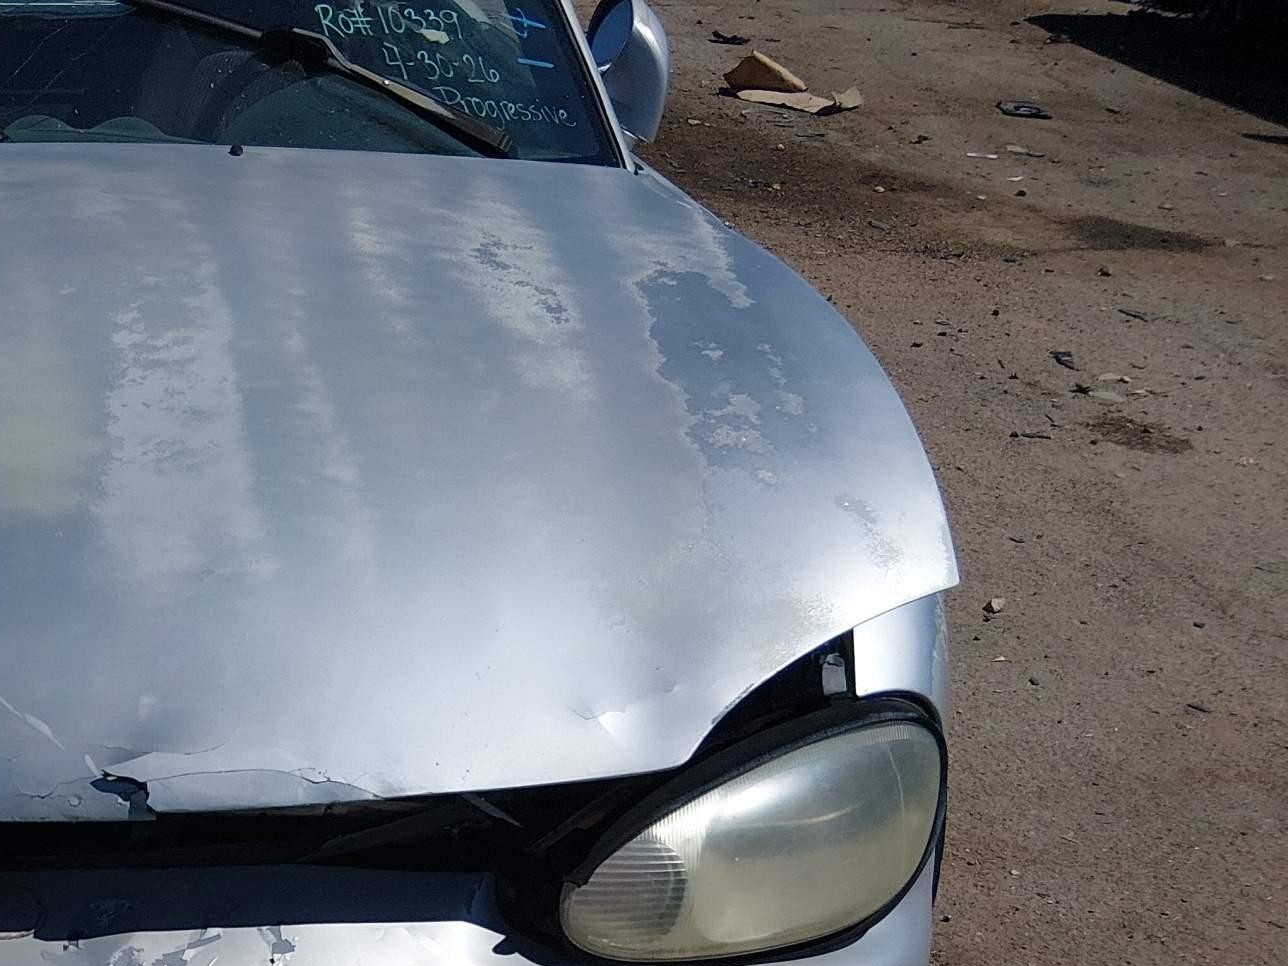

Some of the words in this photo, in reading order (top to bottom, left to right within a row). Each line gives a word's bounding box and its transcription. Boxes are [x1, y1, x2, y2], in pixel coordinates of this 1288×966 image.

[376, 7, 462, 40] 10339
[382, 41, 500, 83] 4-30-26
[432, 86, 577, 131] Progressive
